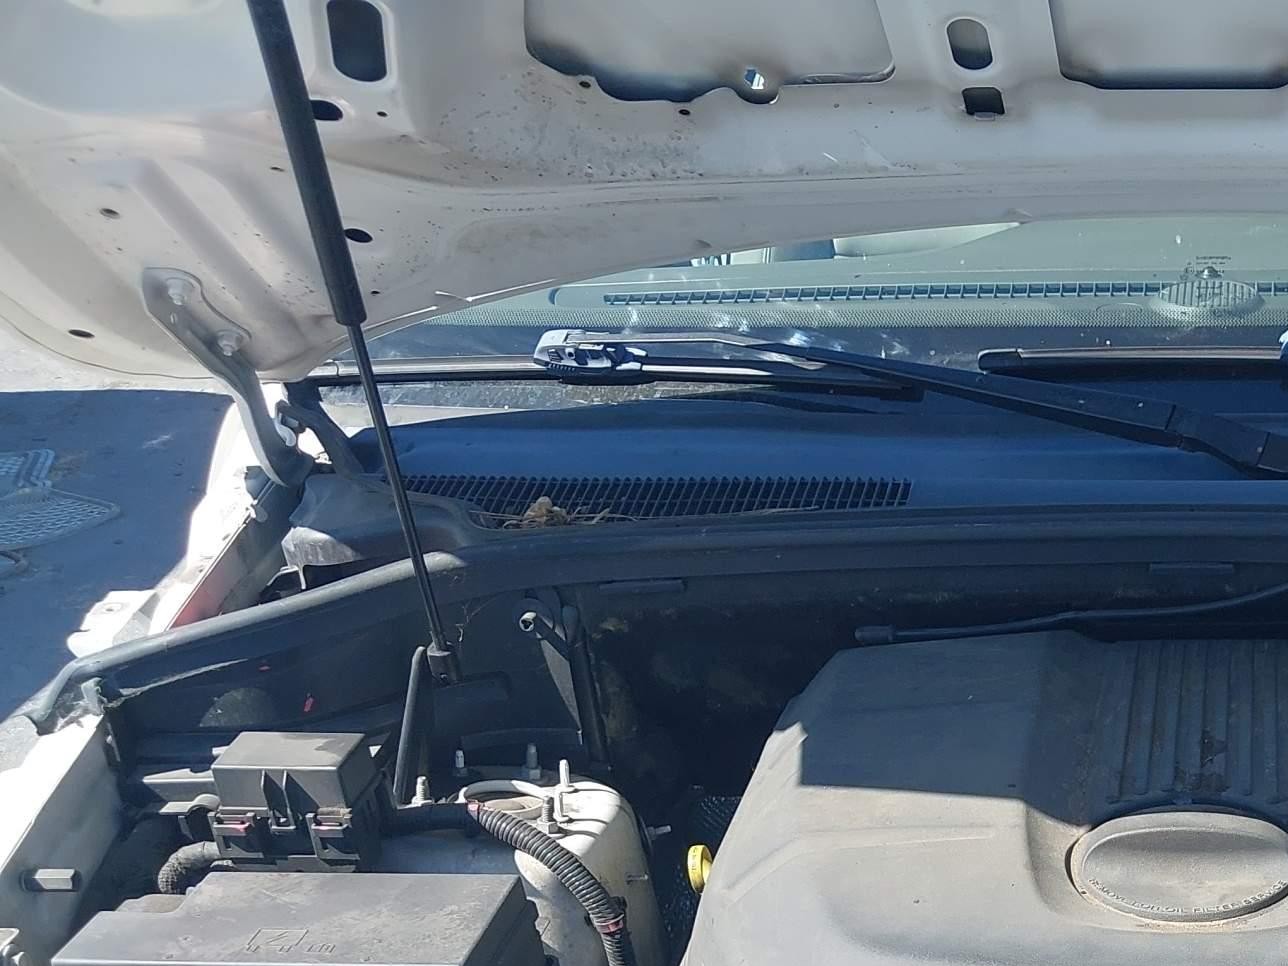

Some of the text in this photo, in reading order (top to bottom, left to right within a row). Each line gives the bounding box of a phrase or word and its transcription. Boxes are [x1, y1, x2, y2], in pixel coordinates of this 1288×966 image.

[1163, 904, 1188, 913] OIL
[1193, 902, 1238, 913] FILTER
[1243, 879, 1288, 906] SERVICE
